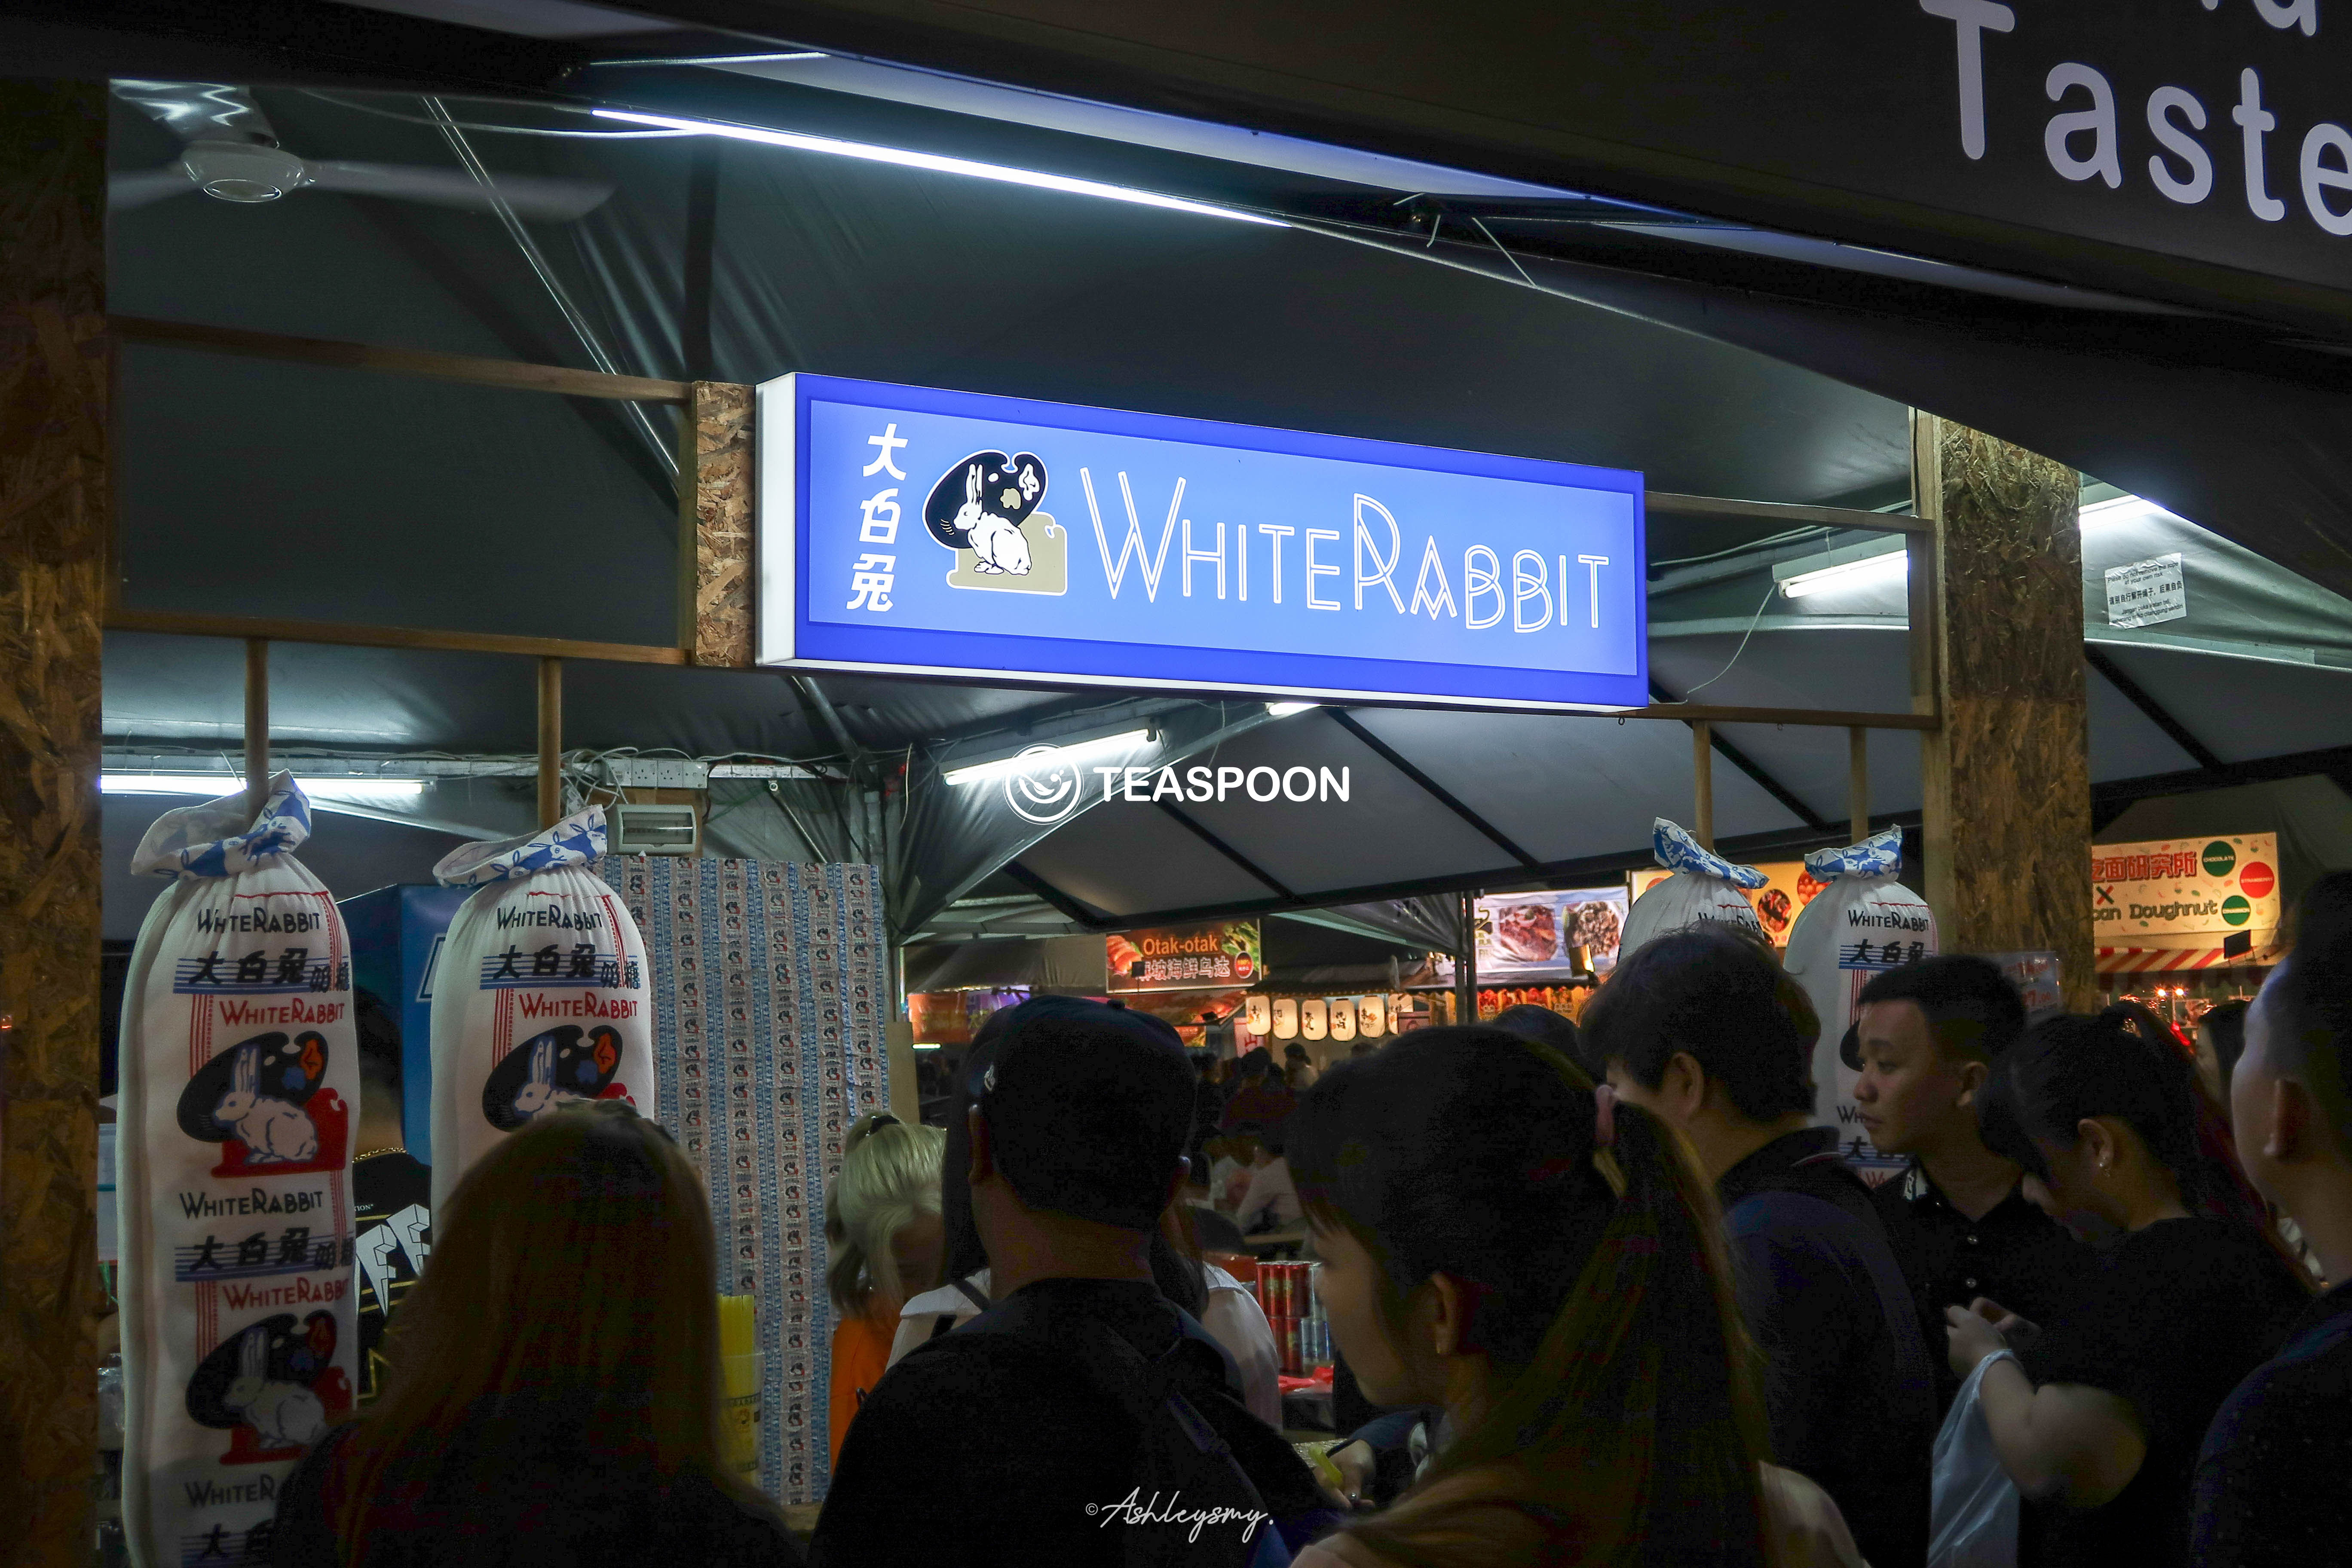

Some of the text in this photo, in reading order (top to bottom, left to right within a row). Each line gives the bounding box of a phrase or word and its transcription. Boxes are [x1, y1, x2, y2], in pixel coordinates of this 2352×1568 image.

[846, 423, 909, 612] 大白兔
[2130, 900, 2218, 920] Doughnut
[493, 943, 596, 980] 大白兔
[1143, 934, 1219, 956] Otak-otak
[189, 948, 308, 984] 大白兔
